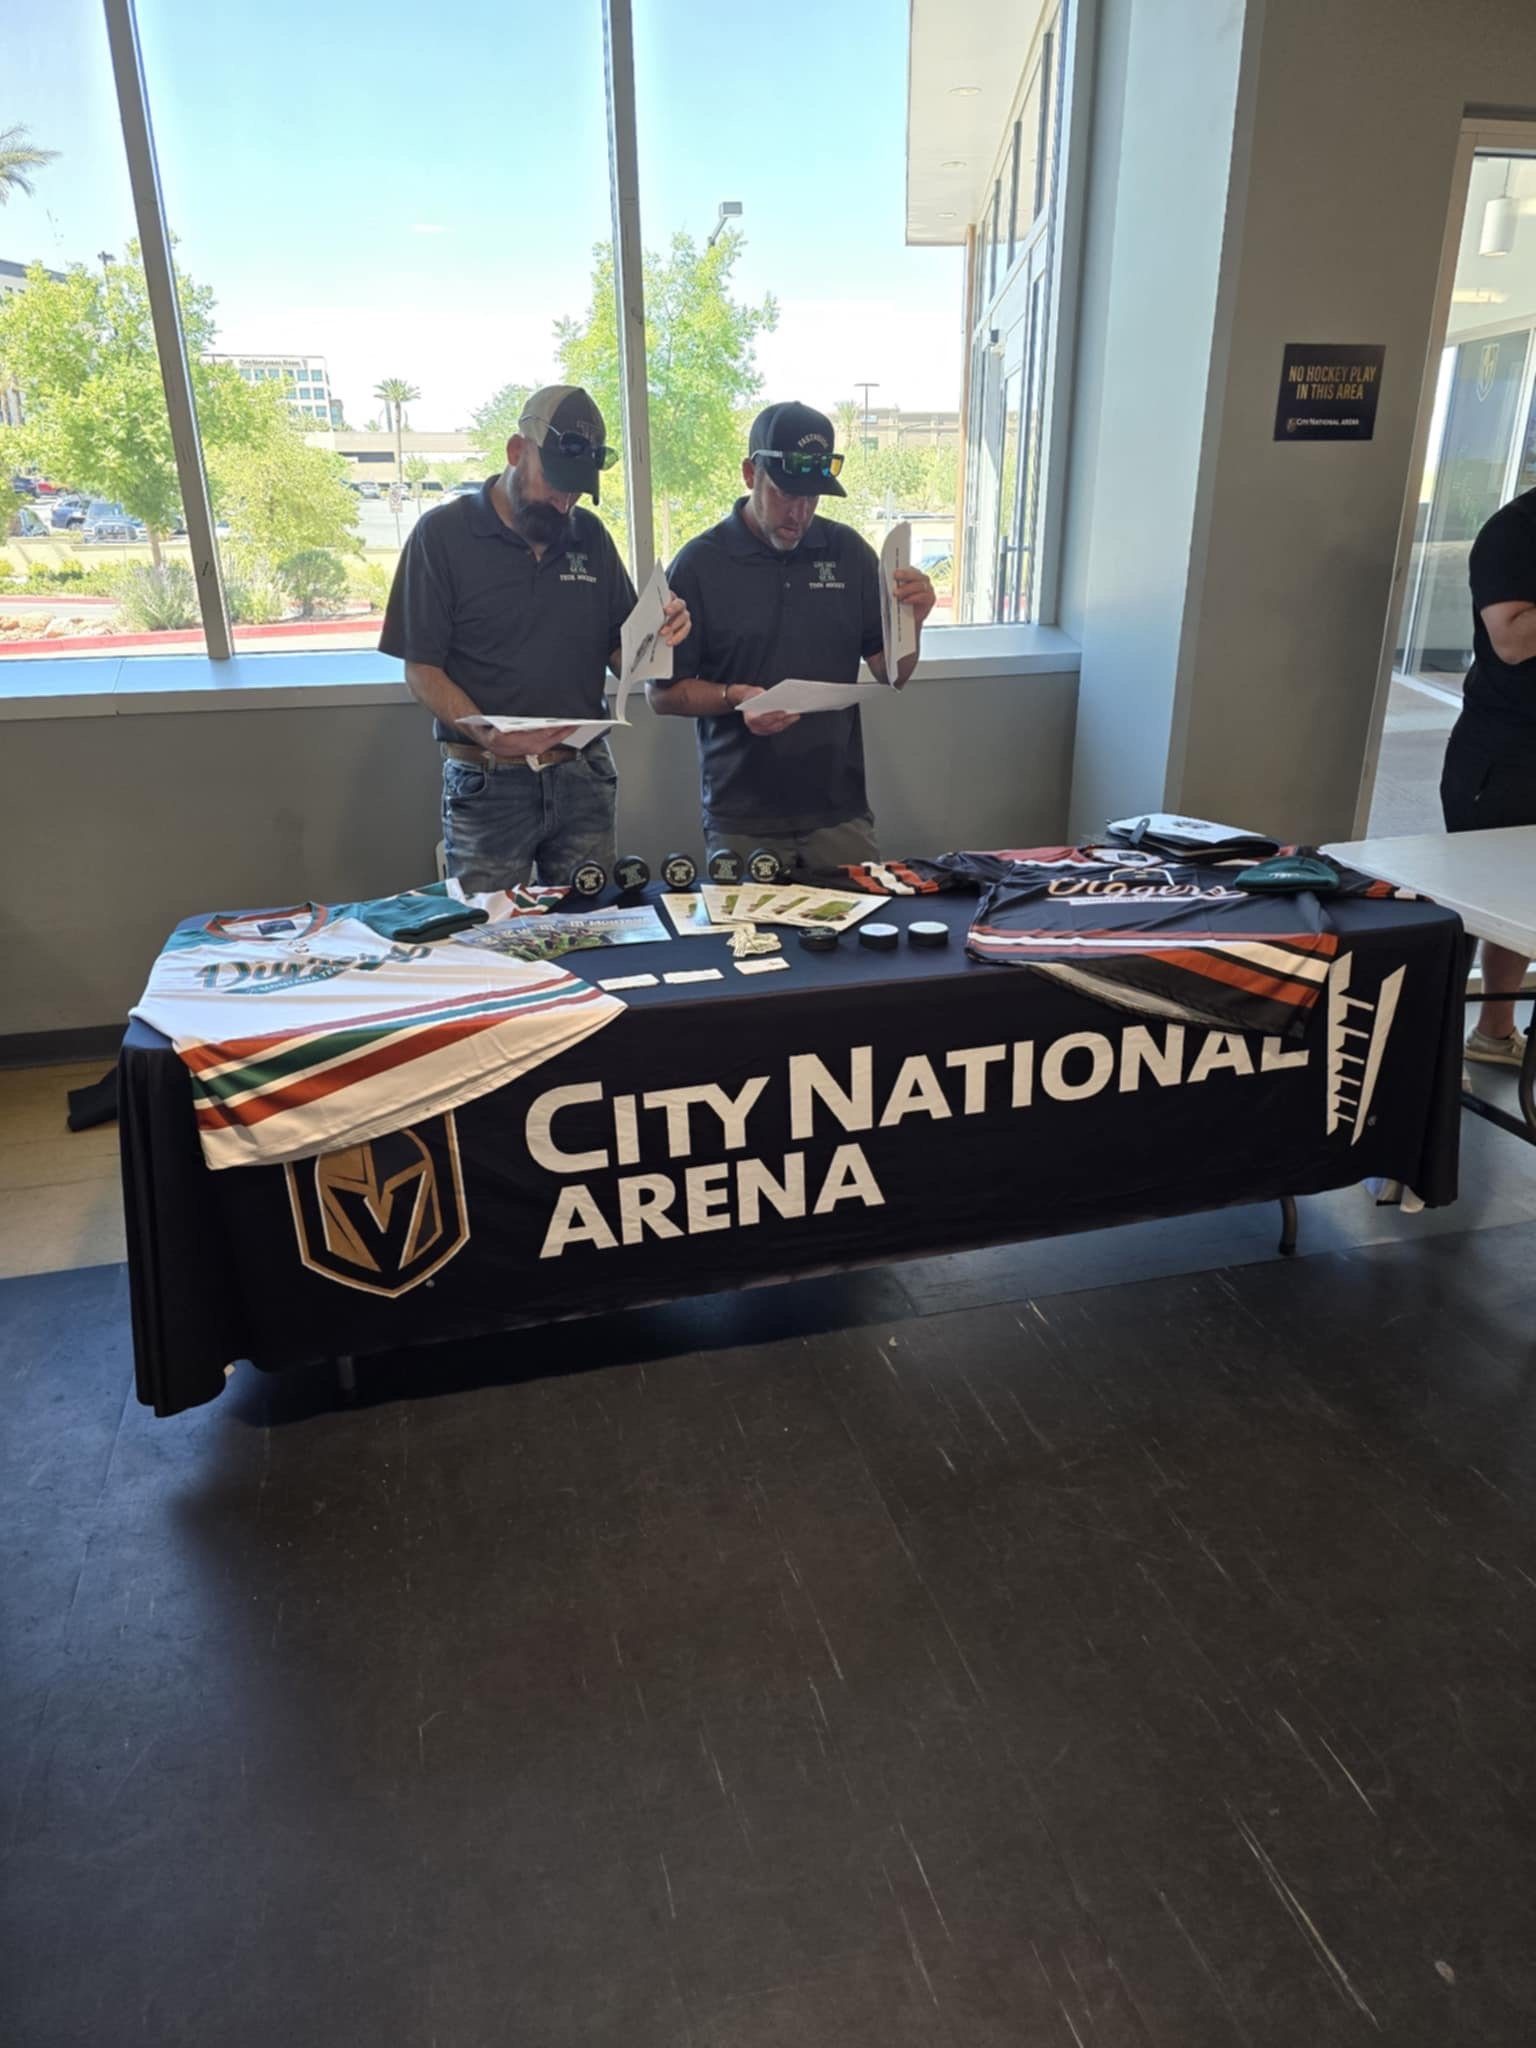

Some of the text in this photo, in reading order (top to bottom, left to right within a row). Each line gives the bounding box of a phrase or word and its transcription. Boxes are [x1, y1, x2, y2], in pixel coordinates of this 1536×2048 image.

[1288, 365, 1376, 383] NO HOCKEY PLAY
[1296, 383, 1364, 400] IN THIS AREA
[1048, 877, 1248, 900] Diggers
[525, 1024, 1310, 1173] CITY NATIONAL
[539, 1143, 885, 1259] ARENA
